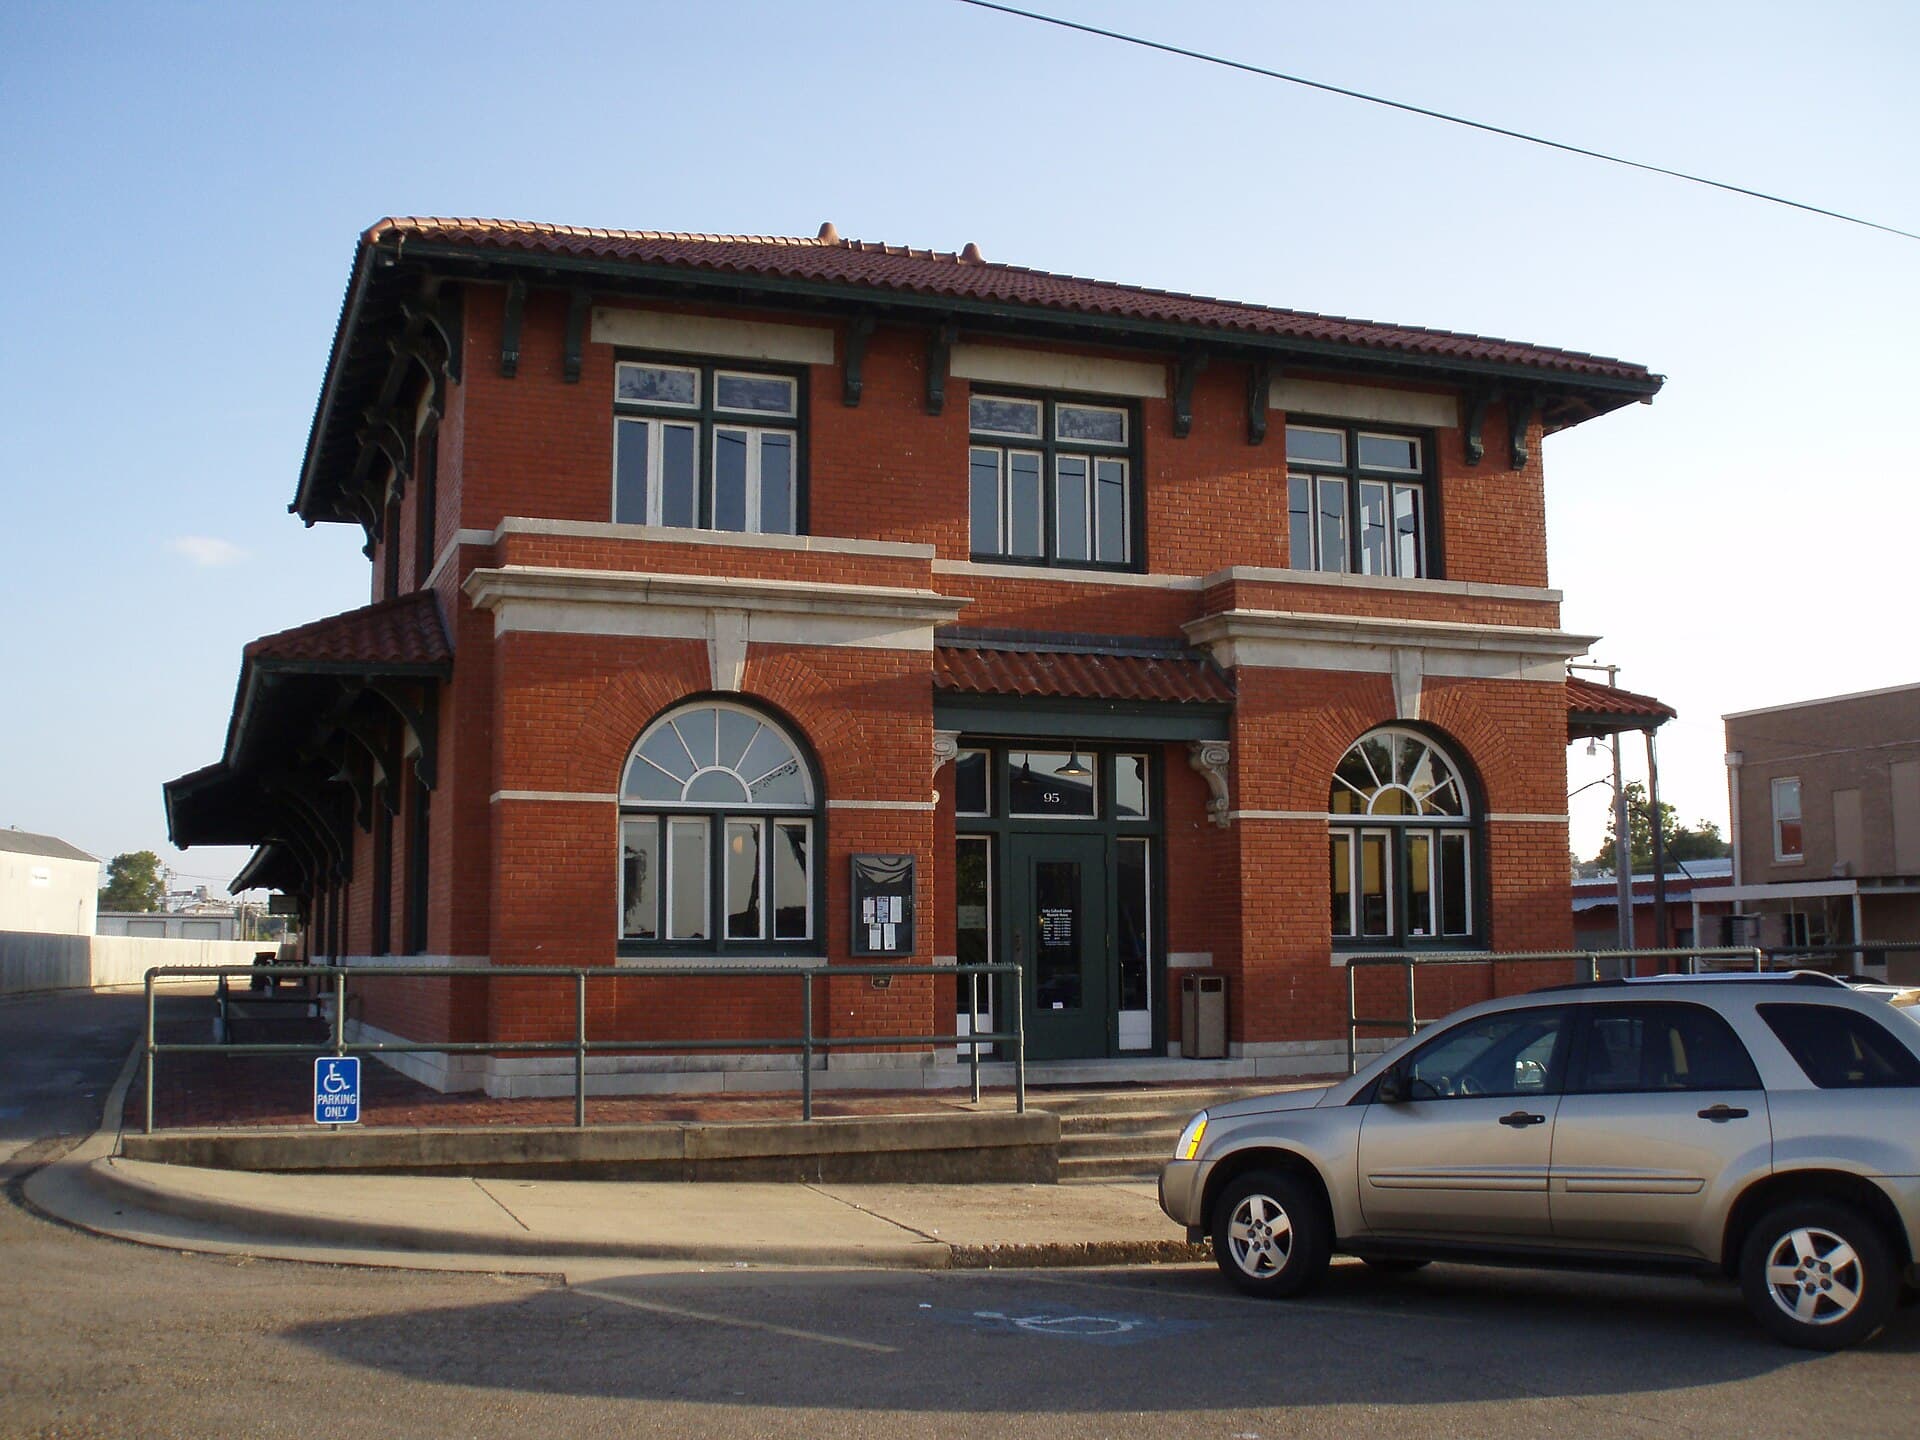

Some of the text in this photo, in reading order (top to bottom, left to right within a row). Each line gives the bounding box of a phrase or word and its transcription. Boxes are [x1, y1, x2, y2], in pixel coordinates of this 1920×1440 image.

[1043, 792, 1060, 803] 95
[317, 1094, 357, 1105] PARKING
[324, 1106, 348, 1118] ONLY
